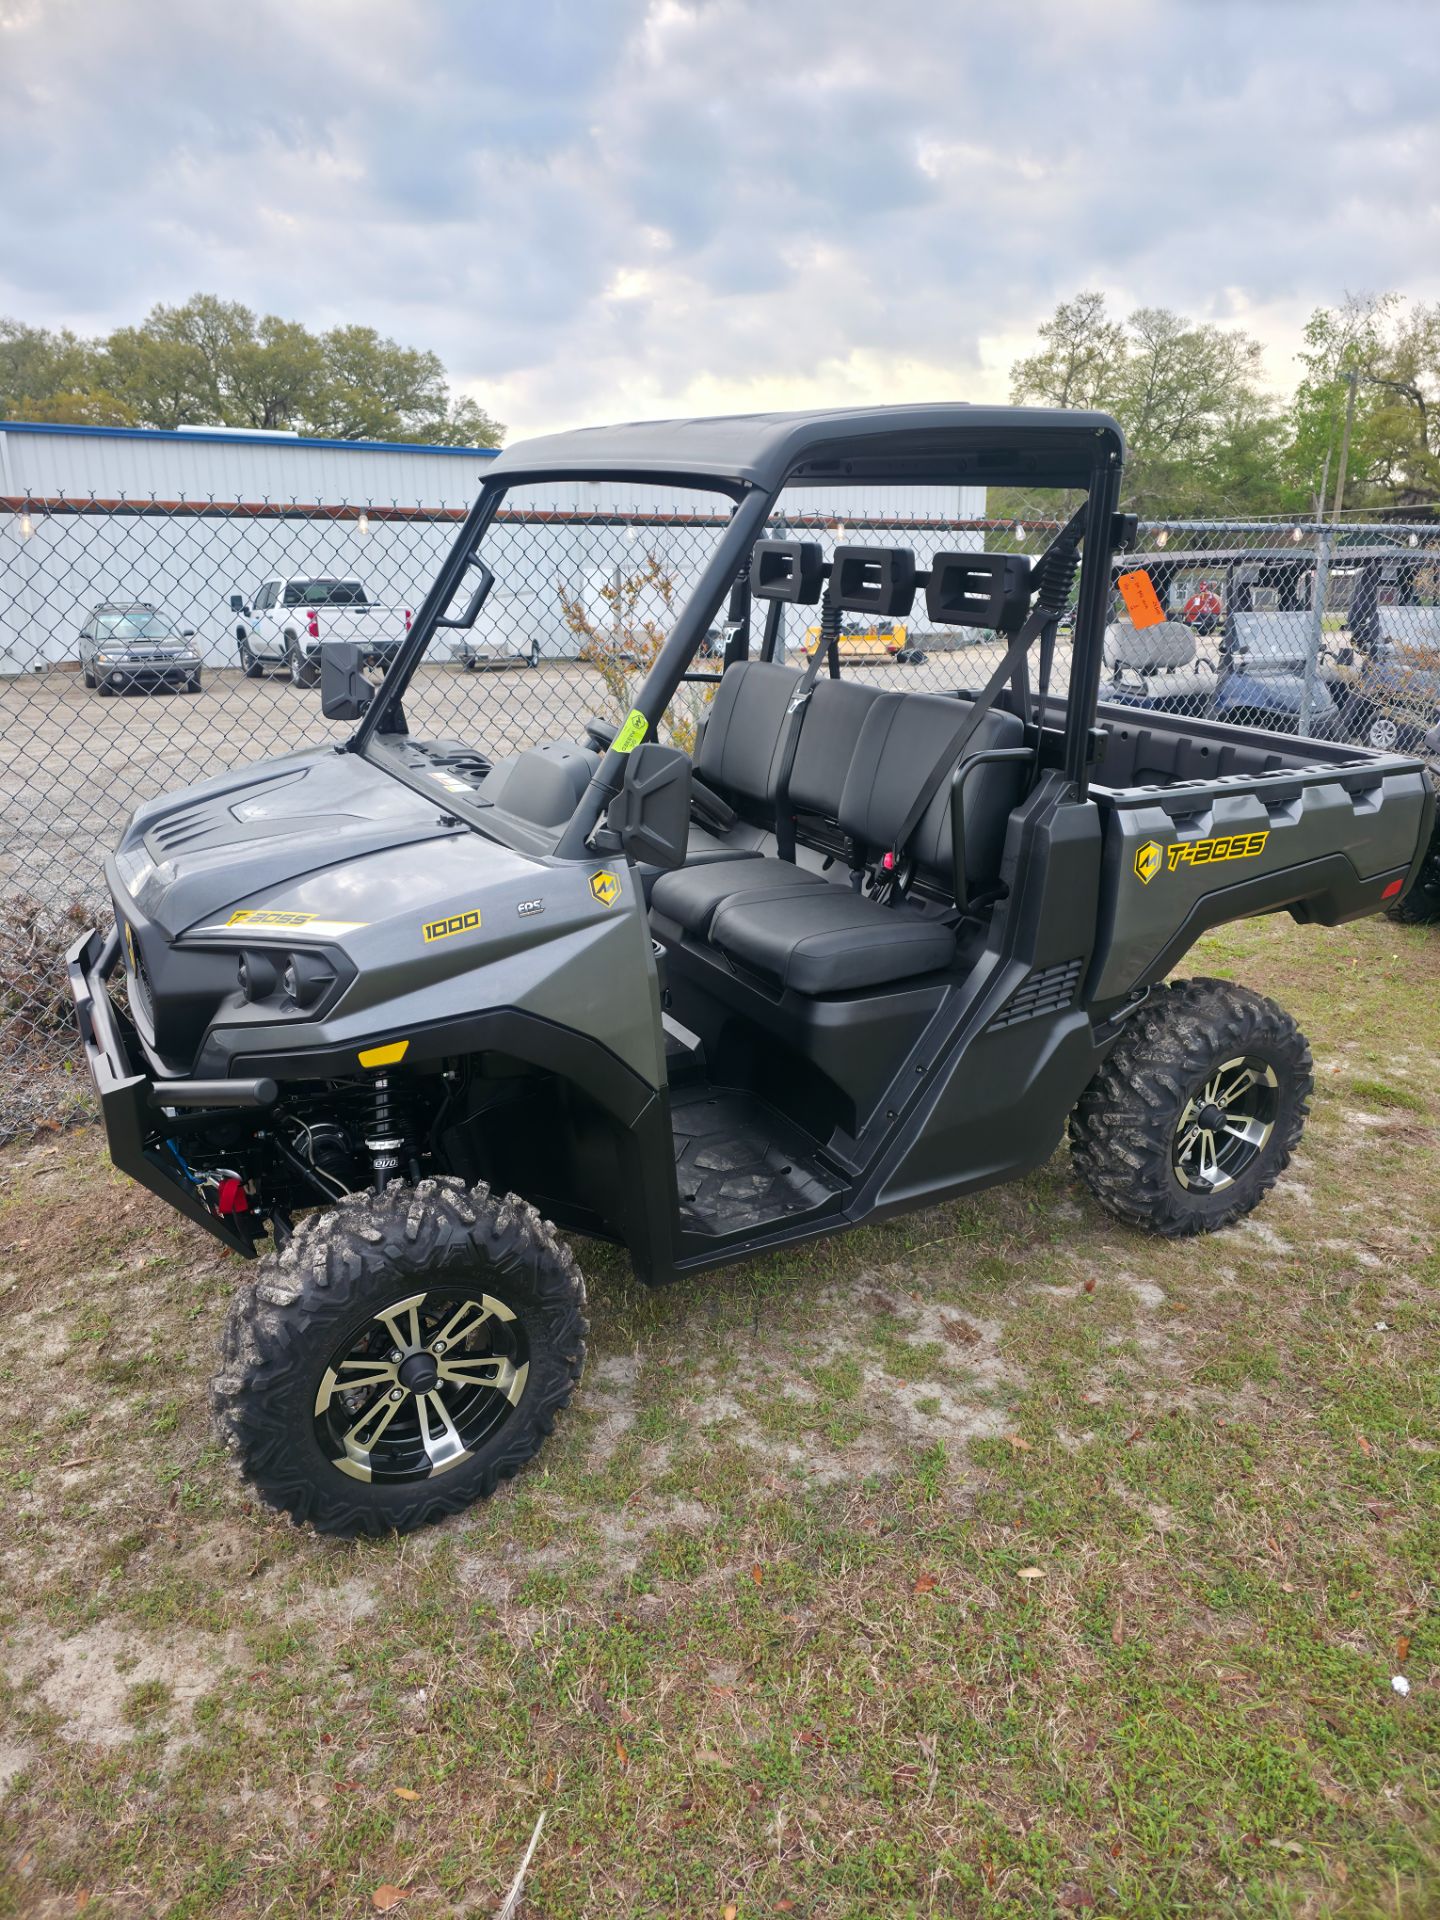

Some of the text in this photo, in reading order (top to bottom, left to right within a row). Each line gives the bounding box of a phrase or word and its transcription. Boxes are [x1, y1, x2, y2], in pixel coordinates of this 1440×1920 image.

[1167, 832, 1268, 870] T-BOSS
[228, 911, 314, 926] T-BOSS
[425, 911, 480, 940] 1000
